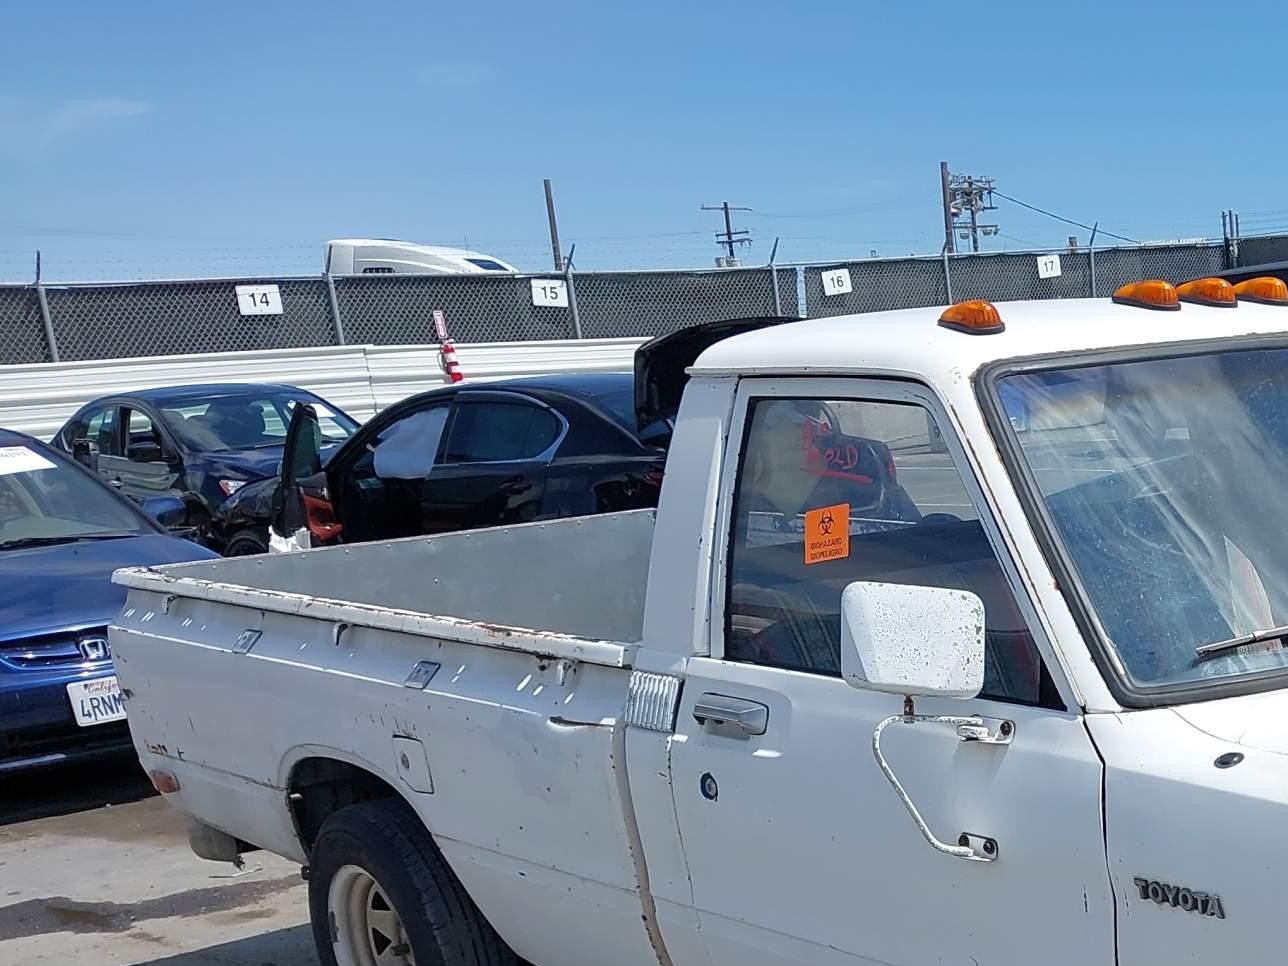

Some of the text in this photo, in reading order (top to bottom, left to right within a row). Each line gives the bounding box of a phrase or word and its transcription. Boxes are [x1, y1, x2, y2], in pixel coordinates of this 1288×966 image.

[1044, 260, 1054, 272] 17
[830, 275, 844, 288] 16
[248, 292, 270, 307] 14
[541, 286, 559, 300] 15
[1133, 877, 1226, 920] TOYOTA
